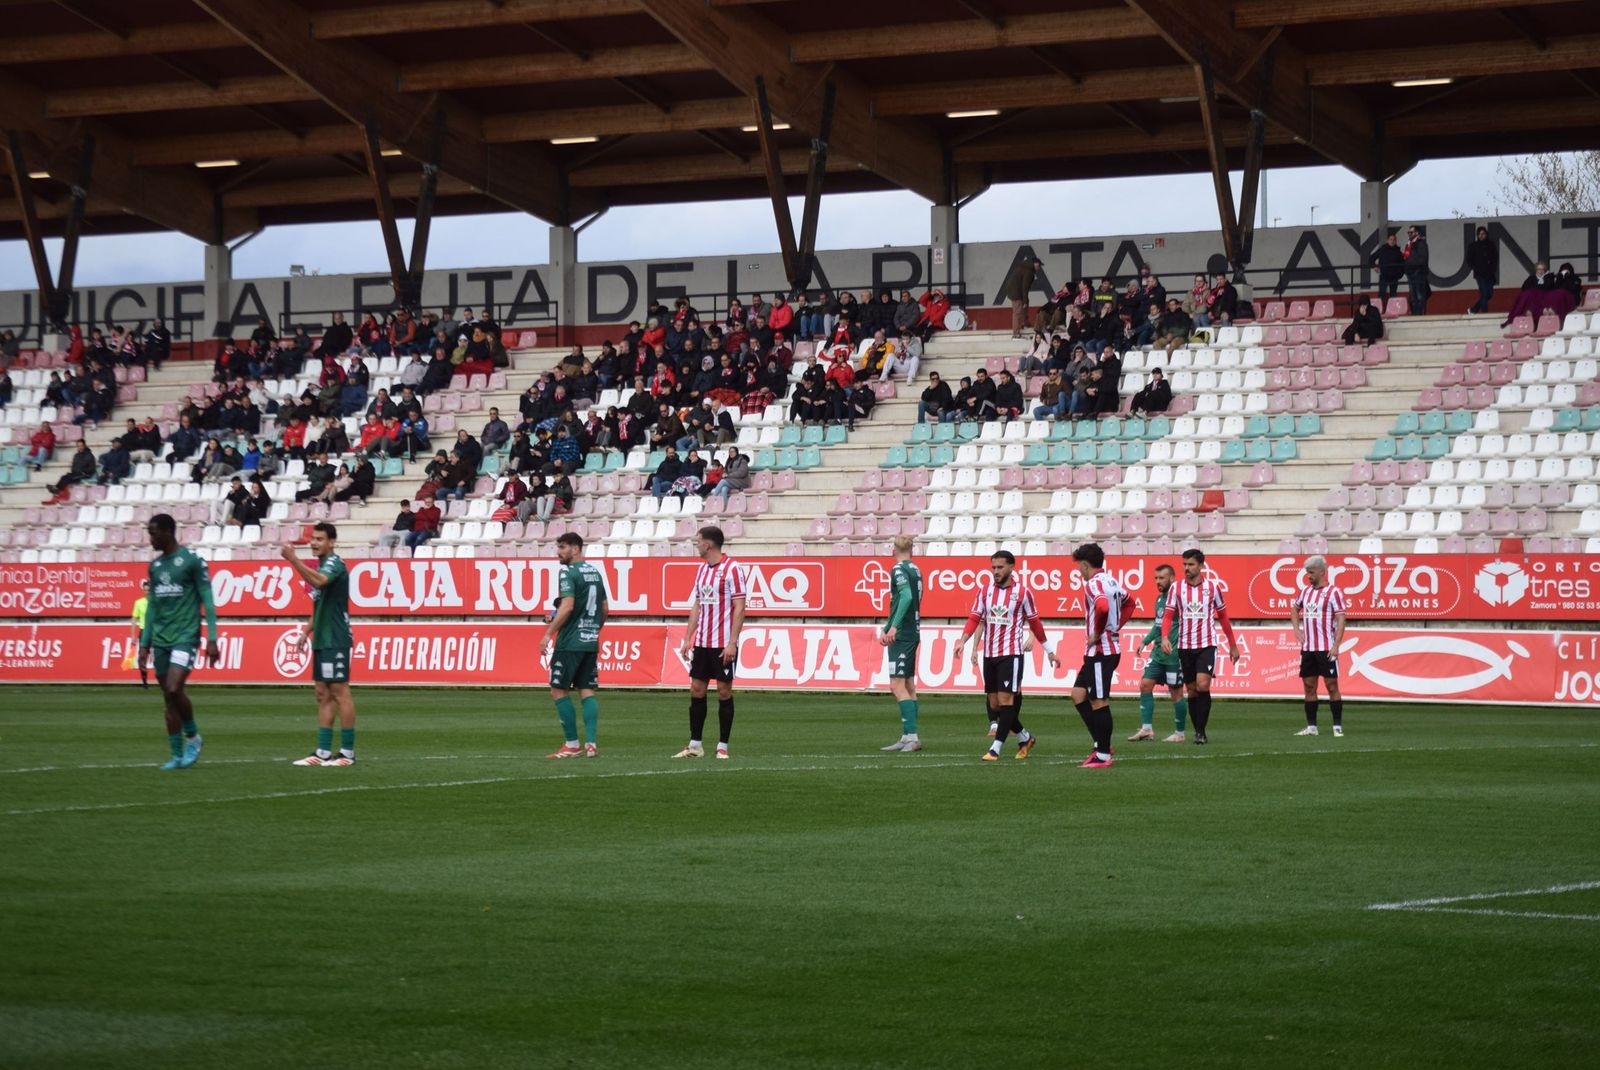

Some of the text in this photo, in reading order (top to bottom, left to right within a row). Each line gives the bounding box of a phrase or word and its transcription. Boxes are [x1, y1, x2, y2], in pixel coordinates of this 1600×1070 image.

[587, 262, 693, 323] DE
[37, 566, 87, 584] Dental
[350, 559, 648, 612] CAJA RUAL
[928, 559, 1144, 591] recotas sud
[1530, 577, 1590, 598] tres
[586, 585, 597, 617] 4
[1370, 599, 1439, 608] JAMONES
[368, 632, 497, 671] FEDERACIÓN
[736, 628, 860, 685] CAJA
